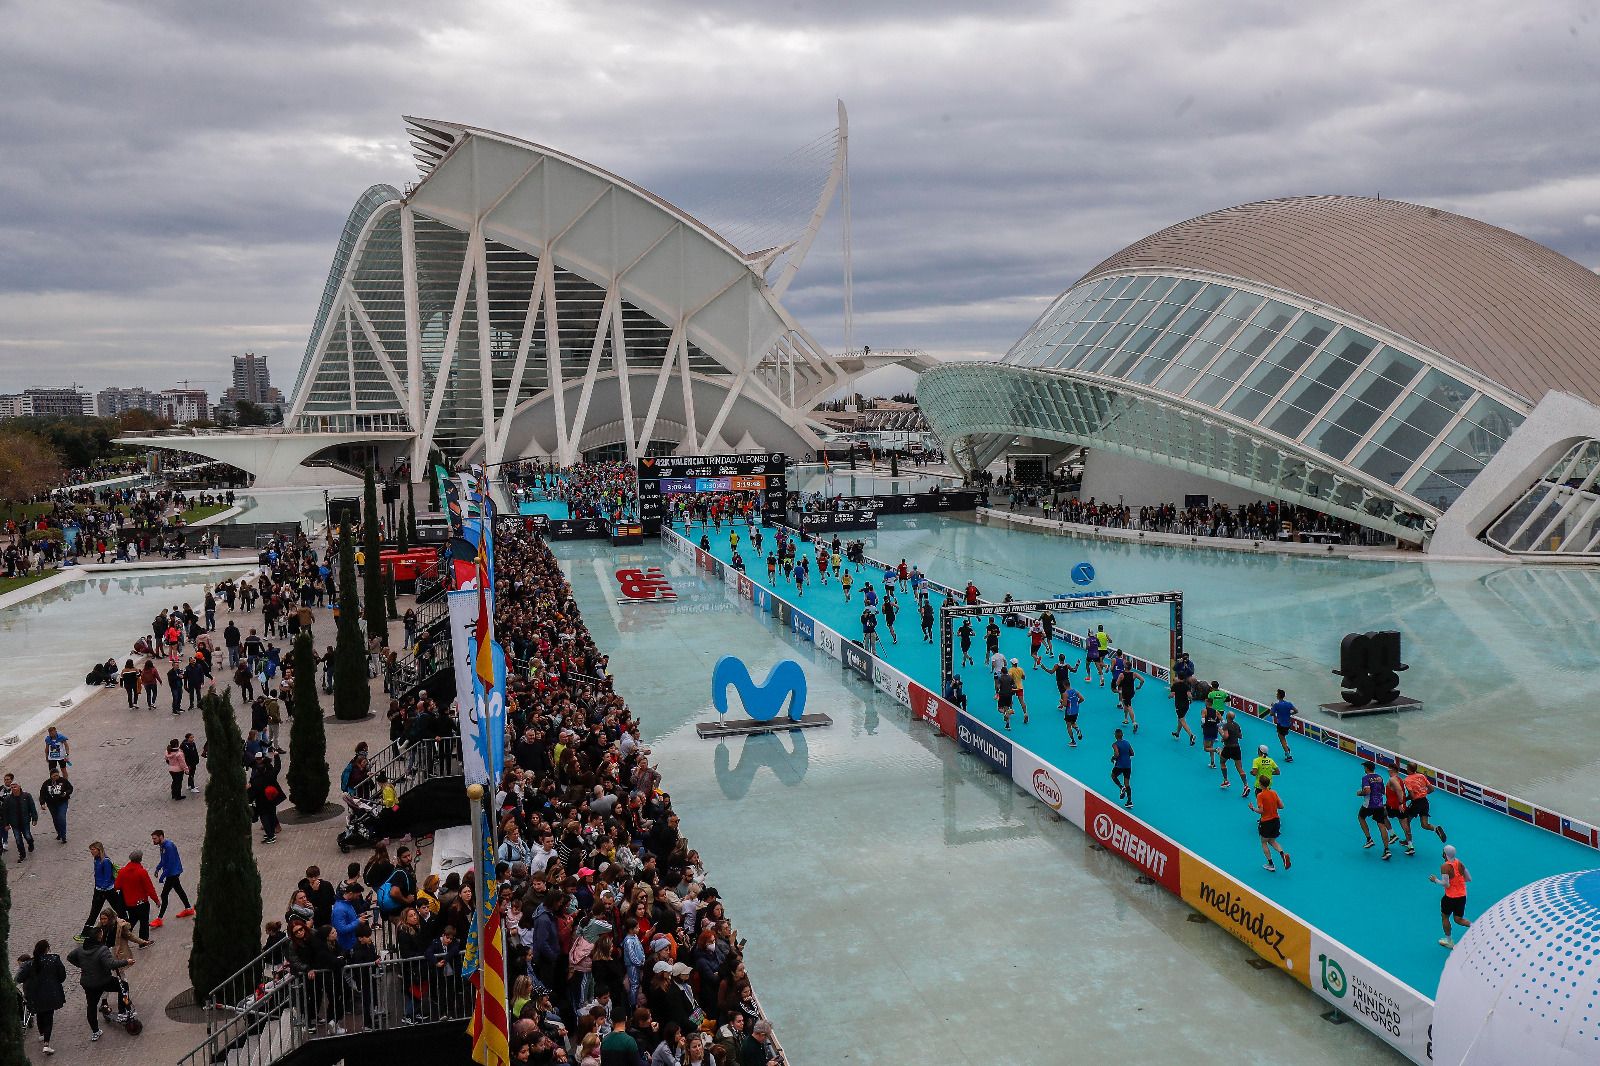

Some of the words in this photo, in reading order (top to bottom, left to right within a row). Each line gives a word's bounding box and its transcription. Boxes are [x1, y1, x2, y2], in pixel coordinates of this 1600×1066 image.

[655, 458, 670, 467] 42K
[671, 457, 705, 466] VALENCIA
[737, 455, 769, 464] ALFONSO
[1011, 604, 1037, 613] FINISHER
[1074, 600, 1099, 608] FINISHER
[1107, 598, 1118, 606] YOU
[1120, 597, 1130, 605] ARE
[1135, 595, 1160, 603] FINISHER
[972, 733, 1007, 768] HYUNDAI
[1035, 774, 1060, 803] Serrano
[1112, 823, 1168, 877] ENERVIT
[1200, 881, 1286, 960] meléndez
[1351, 984, 1401, 1025] TRINIDAD
[1352, 975, 1401, 1012] FUNDACIÓN
[1353, 1000, 1401, 1038] ALFONSO
